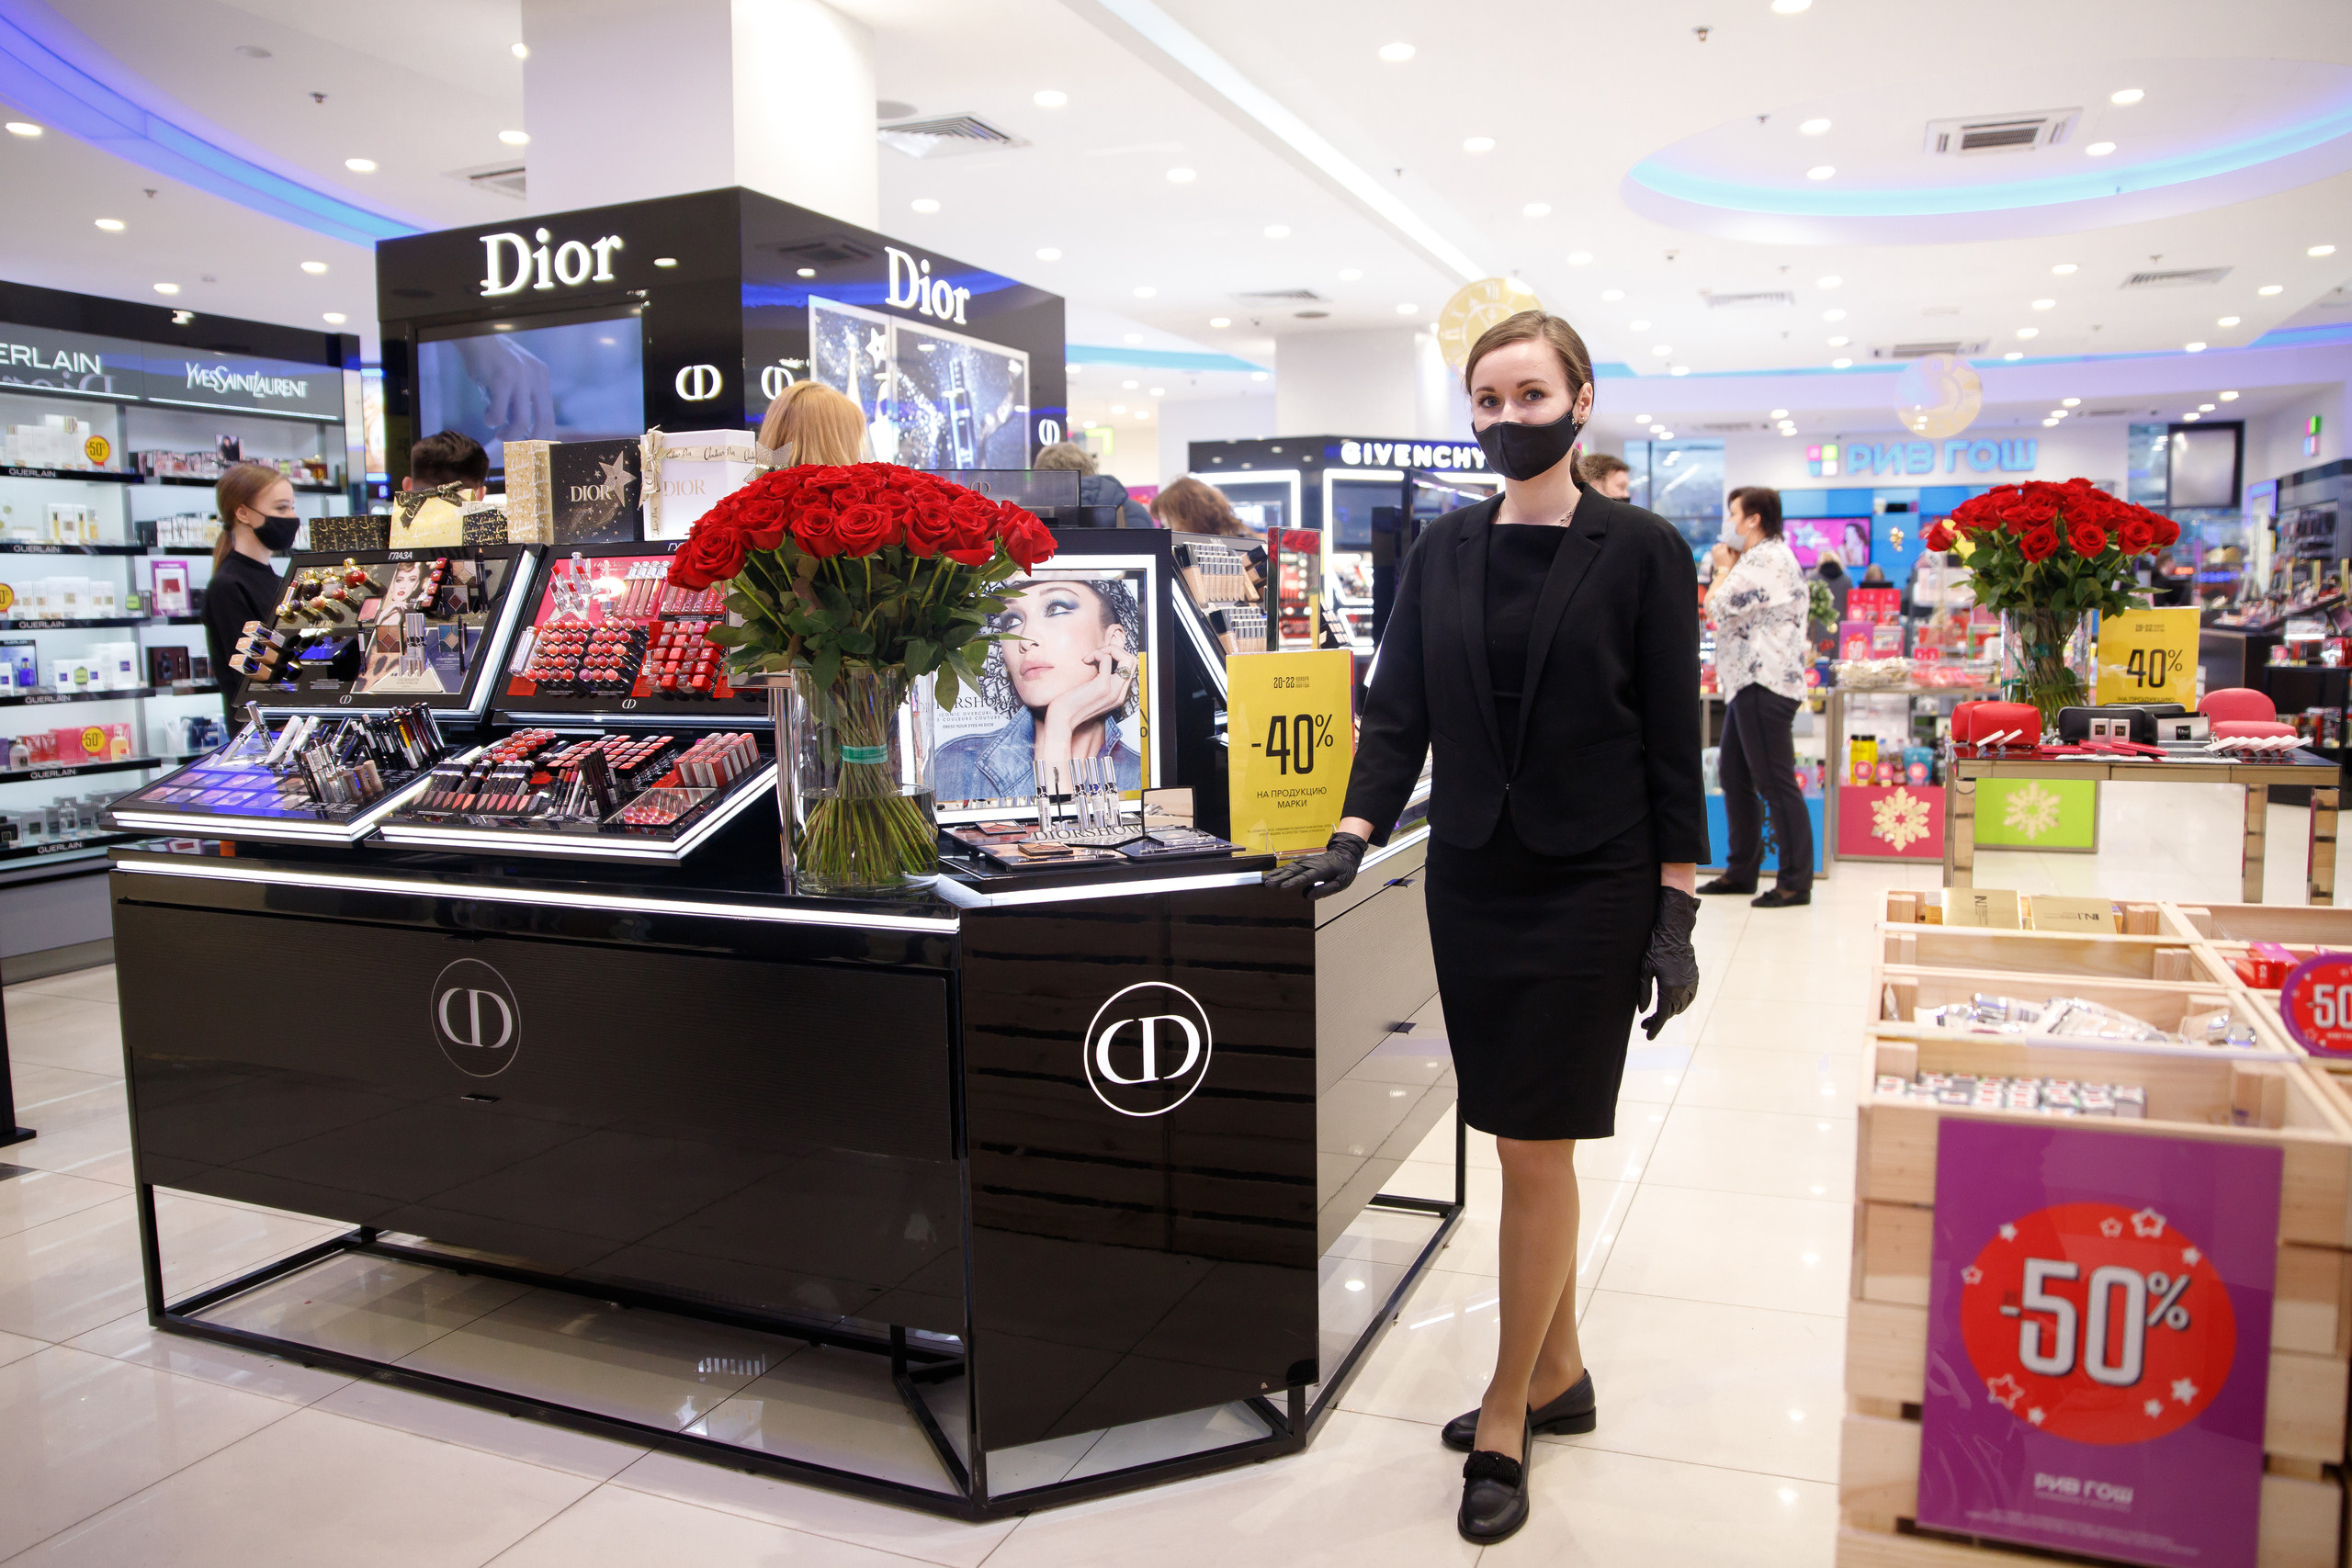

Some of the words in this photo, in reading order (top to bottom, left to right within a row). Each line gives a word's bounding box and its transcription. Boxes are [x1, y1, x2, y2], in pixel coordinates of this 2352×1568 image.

[480, 228, 623, 296] Dior
[884, 246, 970, 324] Dior
[1340, 442, 1487, 469] GIVENCHY
[1847, 441, 1935, 475] РИВ
[1943, 438, 2038, 472] ГОШ
[9, 468, 56, 478] GUERLAIN
[571, 485, 612, 502] DIOR
[664, 479, 706, 496] DIOR
[13, 545, 60, 553] GUERLAIN
[388, 551, 413, 560] ГЛАЗА
[19, 621, 65, 629] GUERLAIN
[1273, 676, 1295, 688] 20-22
[25, 694, 71, 705] GUERLAIN
[1251, 714, 1333, 775] -40%
[30, 769, 76, 780] GUERLAIN
[1271, 787, 1327, 797] ПРОДУКЦИЮ
[1277, 799, 1307, 808] МАРКИ
[1034, 826, 1142, 840] DIORSHOW
[38, 840, 83, 854] GUERLAIN
[1999, 1257, 2191, 1387] -50%
[2034, 1472, 2081, 1495] РИВ
[2083, 1480, 2134, 1504] ГОШ
